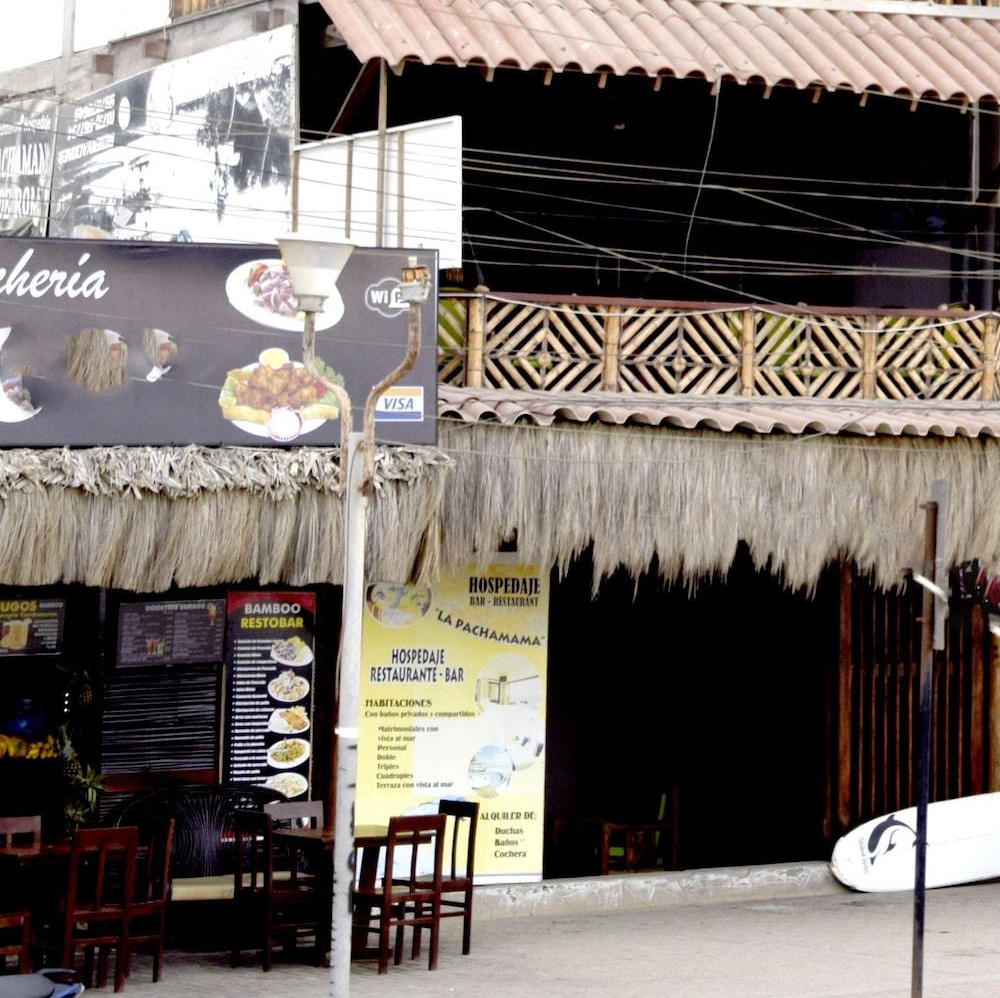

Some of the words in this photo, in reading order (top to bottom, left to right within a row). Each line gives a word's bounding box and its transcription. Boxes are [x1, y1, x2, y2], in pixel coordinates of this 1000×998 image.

[384, 397, 414, 411] VISA
[469, 576, 541, 595] HOSPEDAJE
[469, 596, 486, 607] BAR
[244, 603, 301, 614] BAMBOO
[240, 617, 304, 630] RESTOBAR
[391, 649, 445, 665] HOSPEDAJE
[370, 667, 437, 683] RESTAURANTE
[445, 667, 464, 683] BAR
[365, 699, 432, 708] HABITACIONES
[400, 710, 428, 719] privados
[434, 709, 476, 719] compartidos
[376, 781, 401, 789] Terraza
[480, 811, 521, 821] ALQUILER
[495, 827, 524, 835] Duchas
[494, 838, 519, 847] Baños
[494, 850, 527, 859] Cochera
